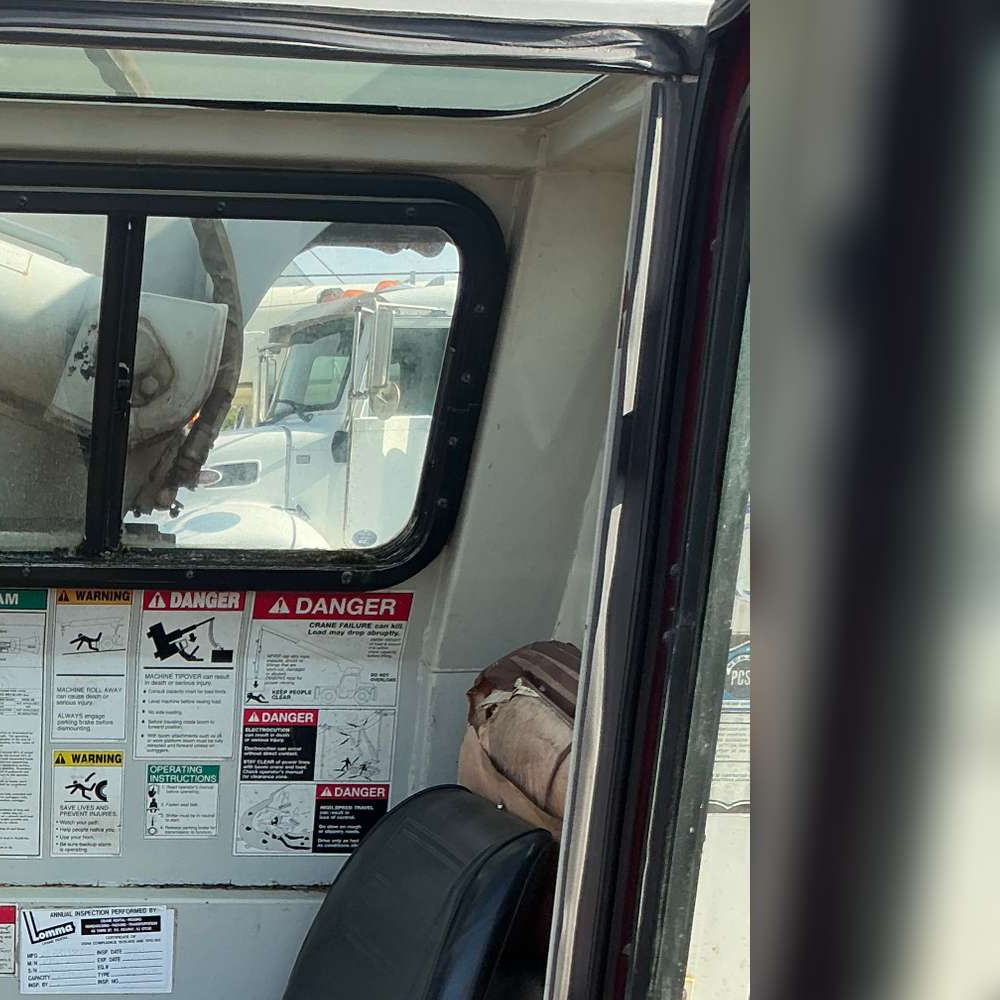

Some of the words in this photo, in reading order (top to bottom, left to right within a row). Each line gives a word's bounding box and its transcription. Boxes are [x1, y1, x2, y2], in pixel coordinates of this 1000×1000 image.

[75, 591, 130, 601] WARNING
[170, 592, 240, 608] DANGER
[296, 598, 396, 615] DANGER
[262, 712, 313, 722] DANGER
[72, 754, 122, 763] WARNING
[334, 788, 385, 797] DANGER
[23, 911, 75, 944] Lomma
